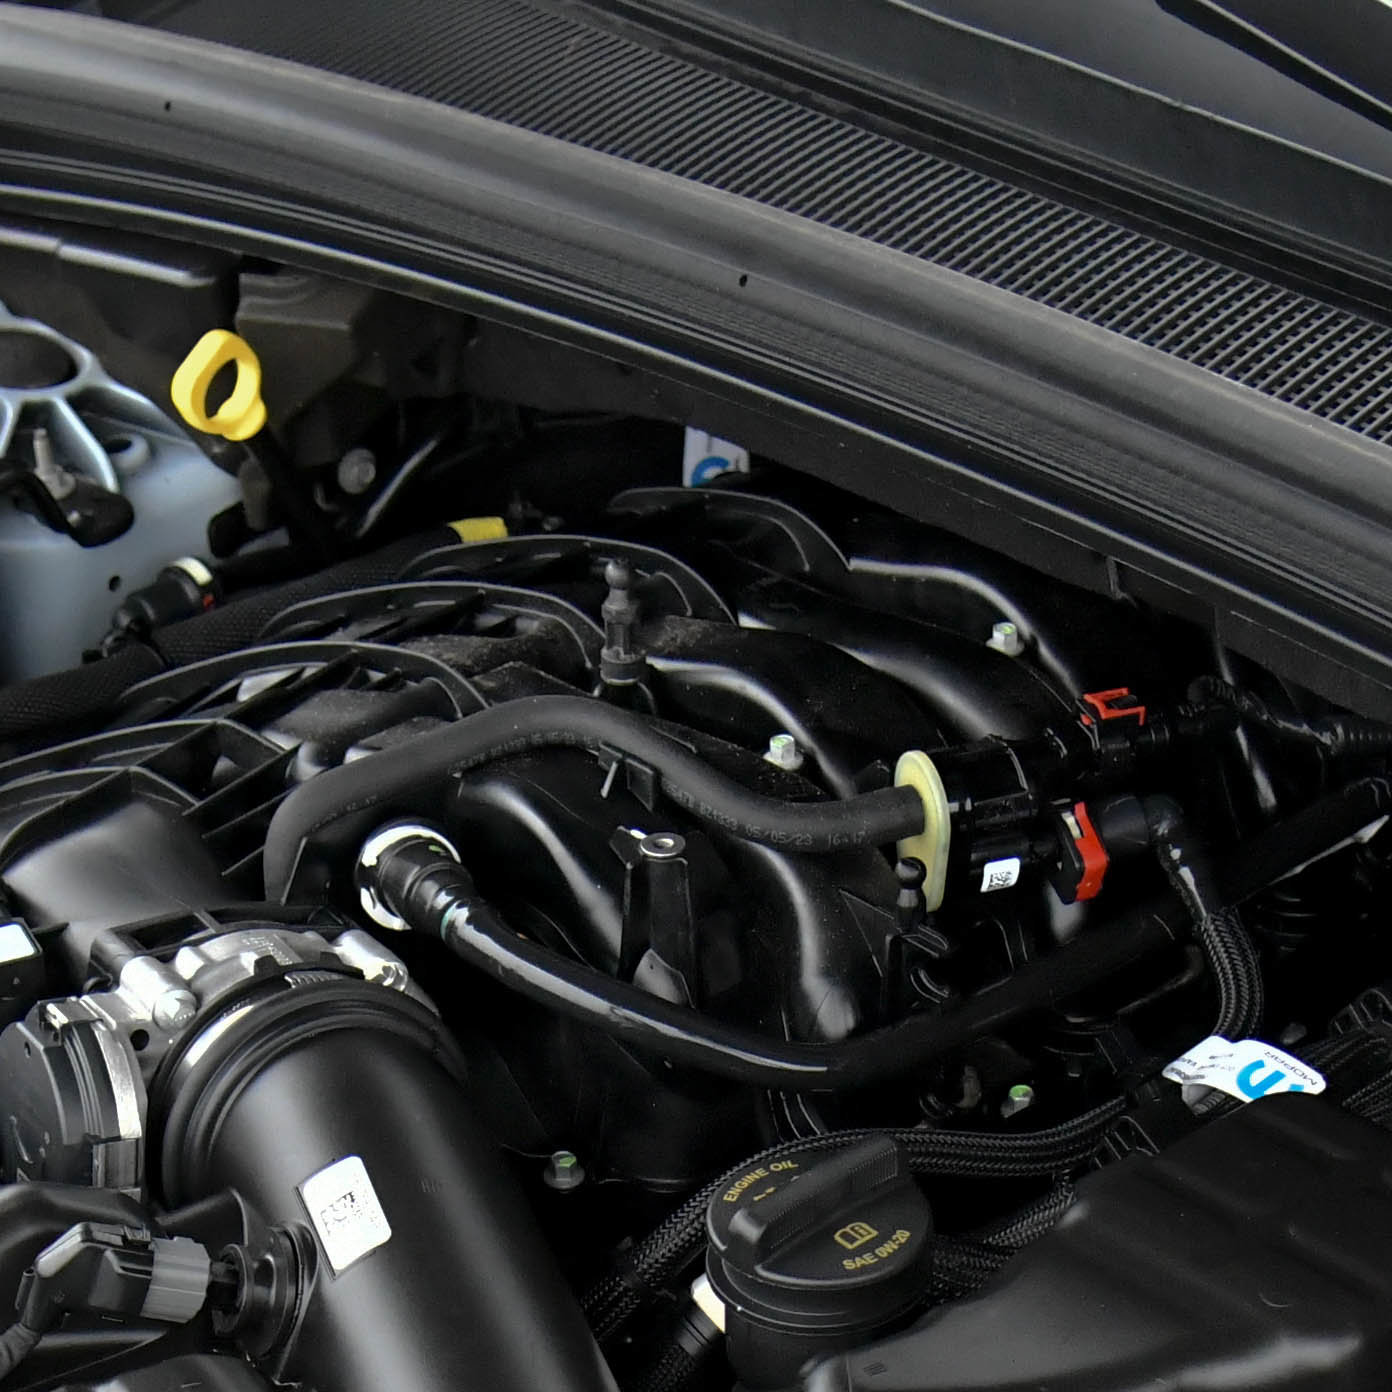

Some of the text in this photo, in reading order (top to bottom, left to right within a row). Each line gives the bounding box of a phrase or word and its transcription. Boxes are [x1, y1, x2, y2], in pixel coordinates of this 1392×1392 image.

[1264, 1049, 1318, 1086] MOPAR
[722, 1166, 770, 1203] ENGINE
[769, 1159, 799, 1173] OIL
[842, 1229, 912, 1271] SAE 0W-20
